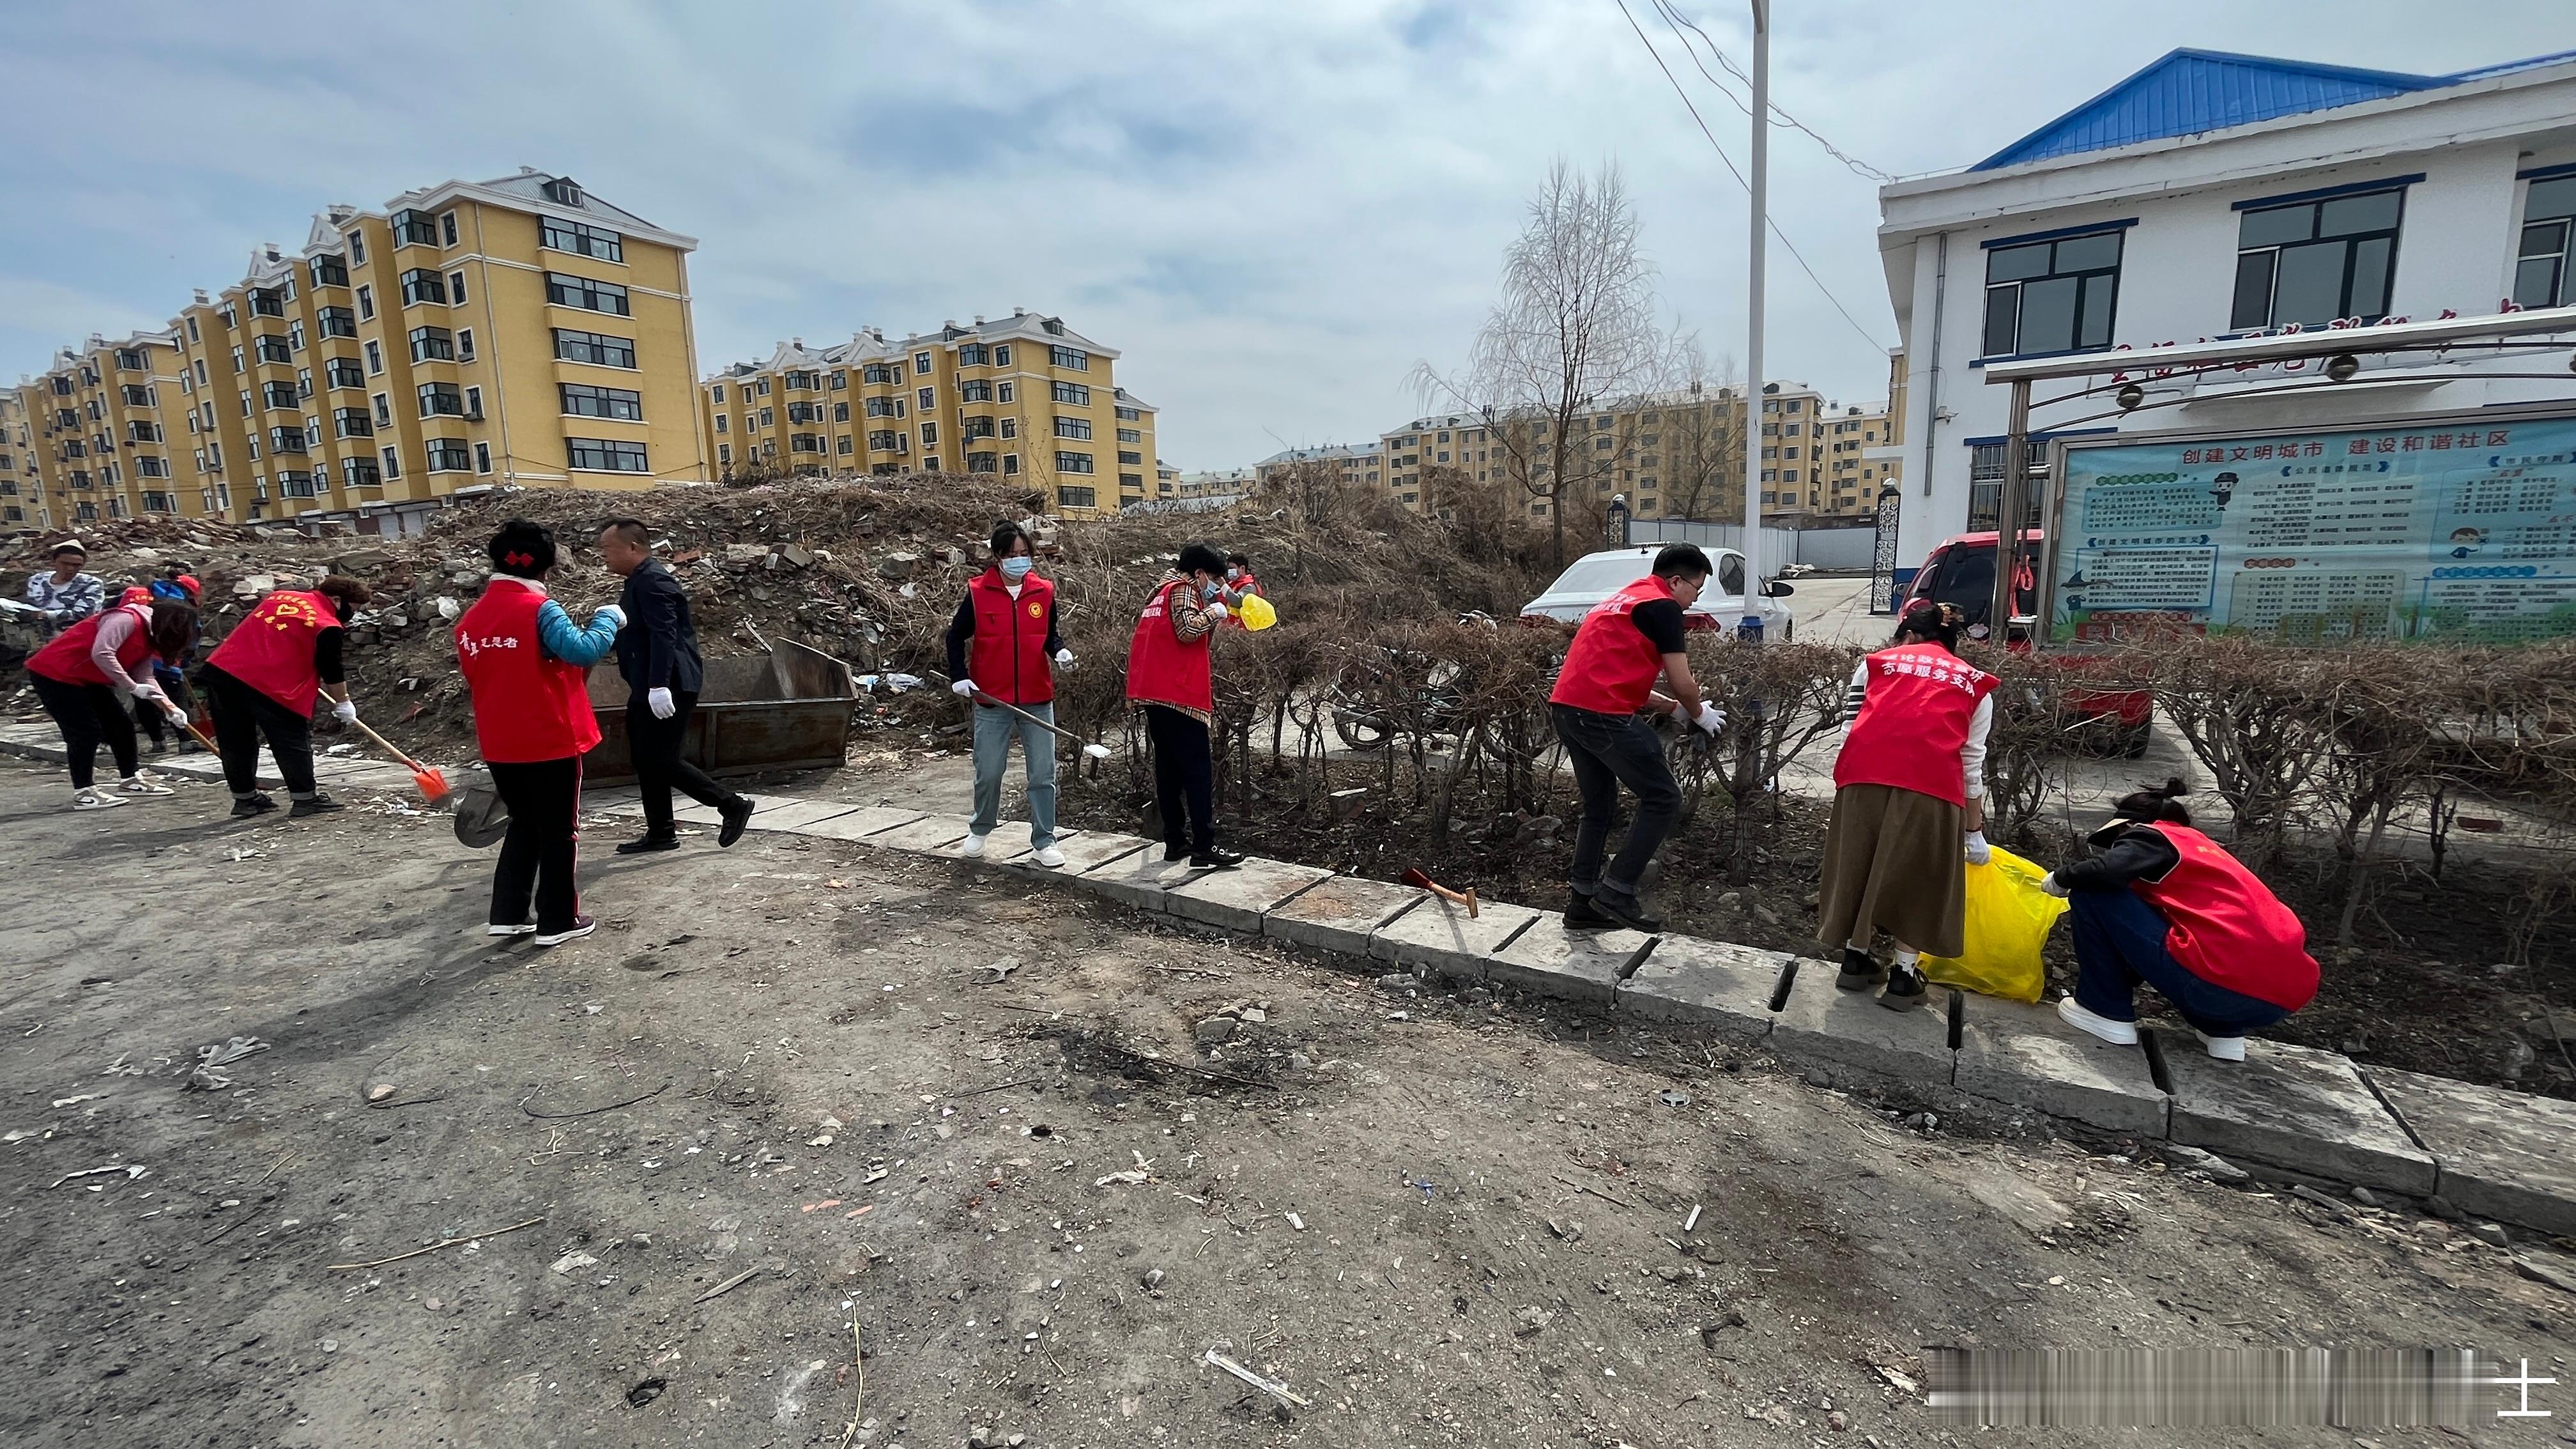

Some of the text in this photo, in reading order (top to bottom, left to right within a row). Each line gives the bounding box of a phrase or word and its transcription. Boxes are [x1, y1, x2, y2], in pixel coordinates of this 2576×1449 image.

[2182, 430, 2510, 464] 创建文明城市 建设和谐社区
